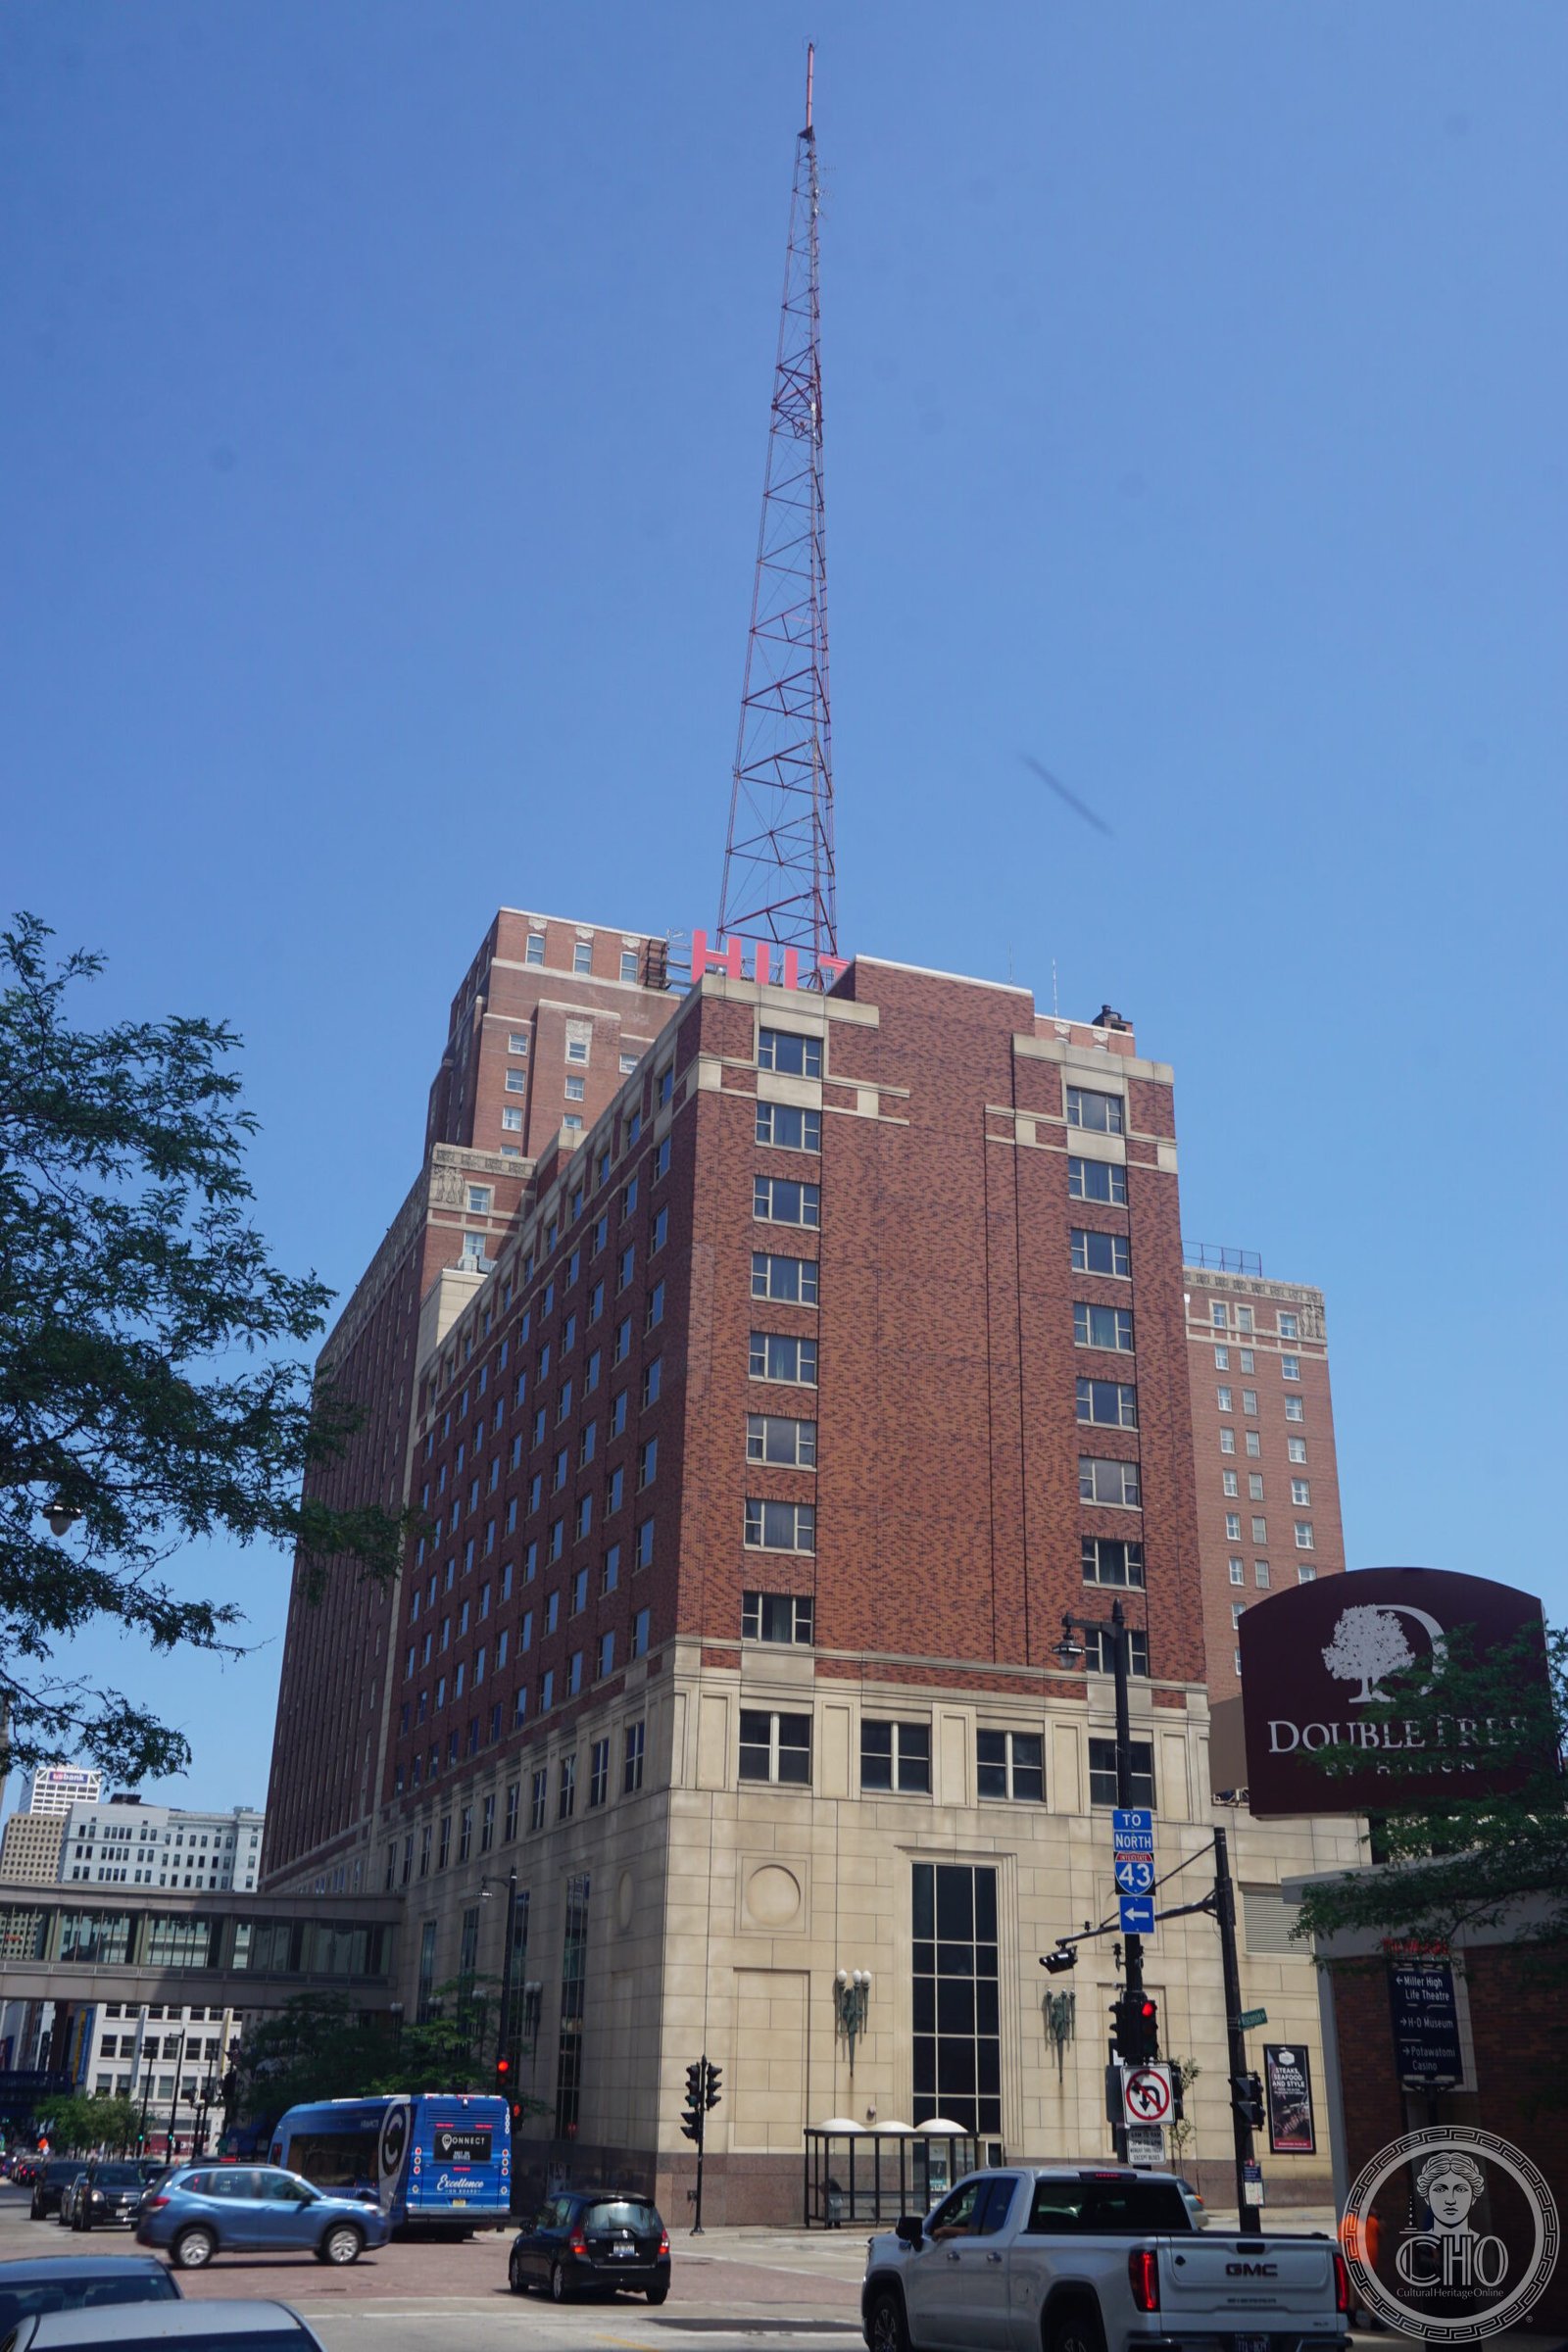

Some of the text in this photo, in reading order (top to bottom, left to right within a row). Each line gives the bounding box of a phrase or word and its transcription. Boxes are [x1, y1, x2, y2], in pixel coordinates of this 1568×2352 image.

[1122, 1814, 1142, 1827] TO
[1115, 1834, 1152, 1849] NORTH
[1119, 1863, 1151, 1886] 43
[1403, 1976, 1443, 1990] Miller High
[1405, 1989, 1449, 2001] Life Theatre
[1424, 2017, 1453, 2029] Museum
[1410, 2045, 1455, 2058] Potawatomi
[1412, 2060, 1438, 2071] Casino
[436, 2174, 484, 2191] Excellence
[1226, 2263, 1278, 2277] GMC
